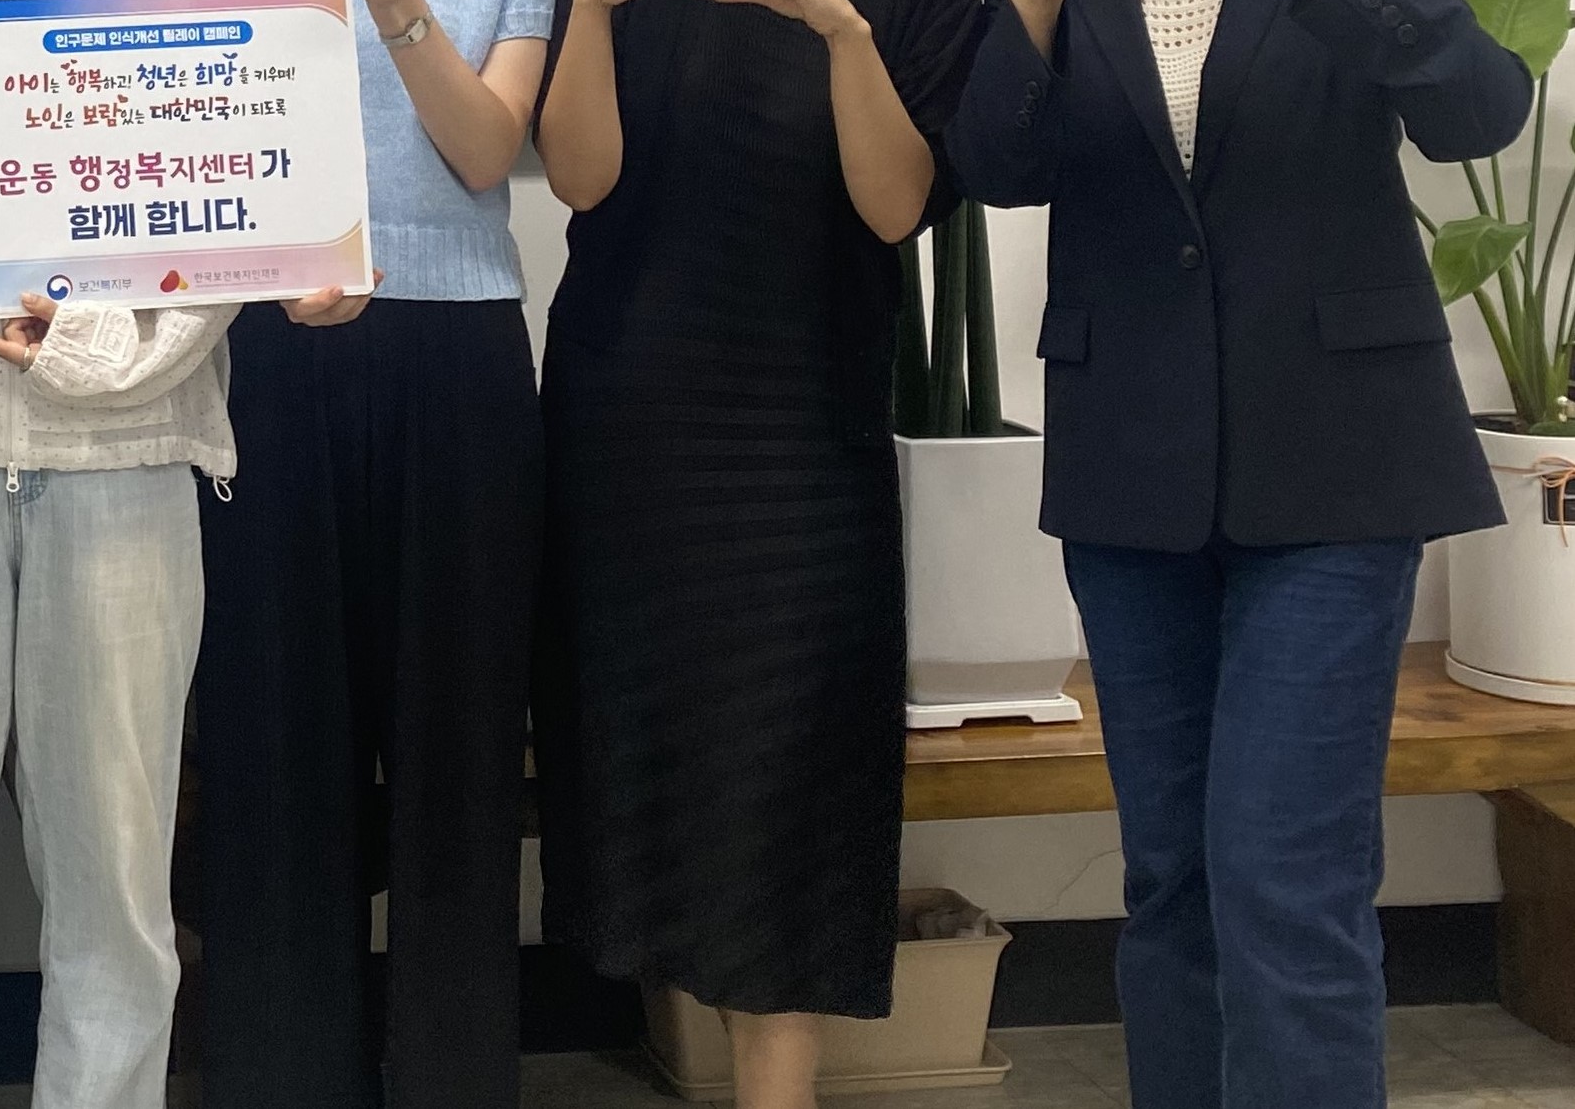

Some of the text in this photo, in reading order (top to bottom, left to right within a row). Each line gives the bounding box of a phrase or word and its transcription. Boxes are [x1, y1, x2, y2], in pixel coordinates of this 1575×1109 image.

[53, 23, 241, 49] 인구문제 인식개선 릴레이 캠페인
[4, 59, 296, 95] 아이는 행복하고! 청년은 희망을 키우며!
[24, 94, 287, 130] 노인은 보람있는 대한민국이 되도록
[68, 196, 258, 241] 함께 합니다.
